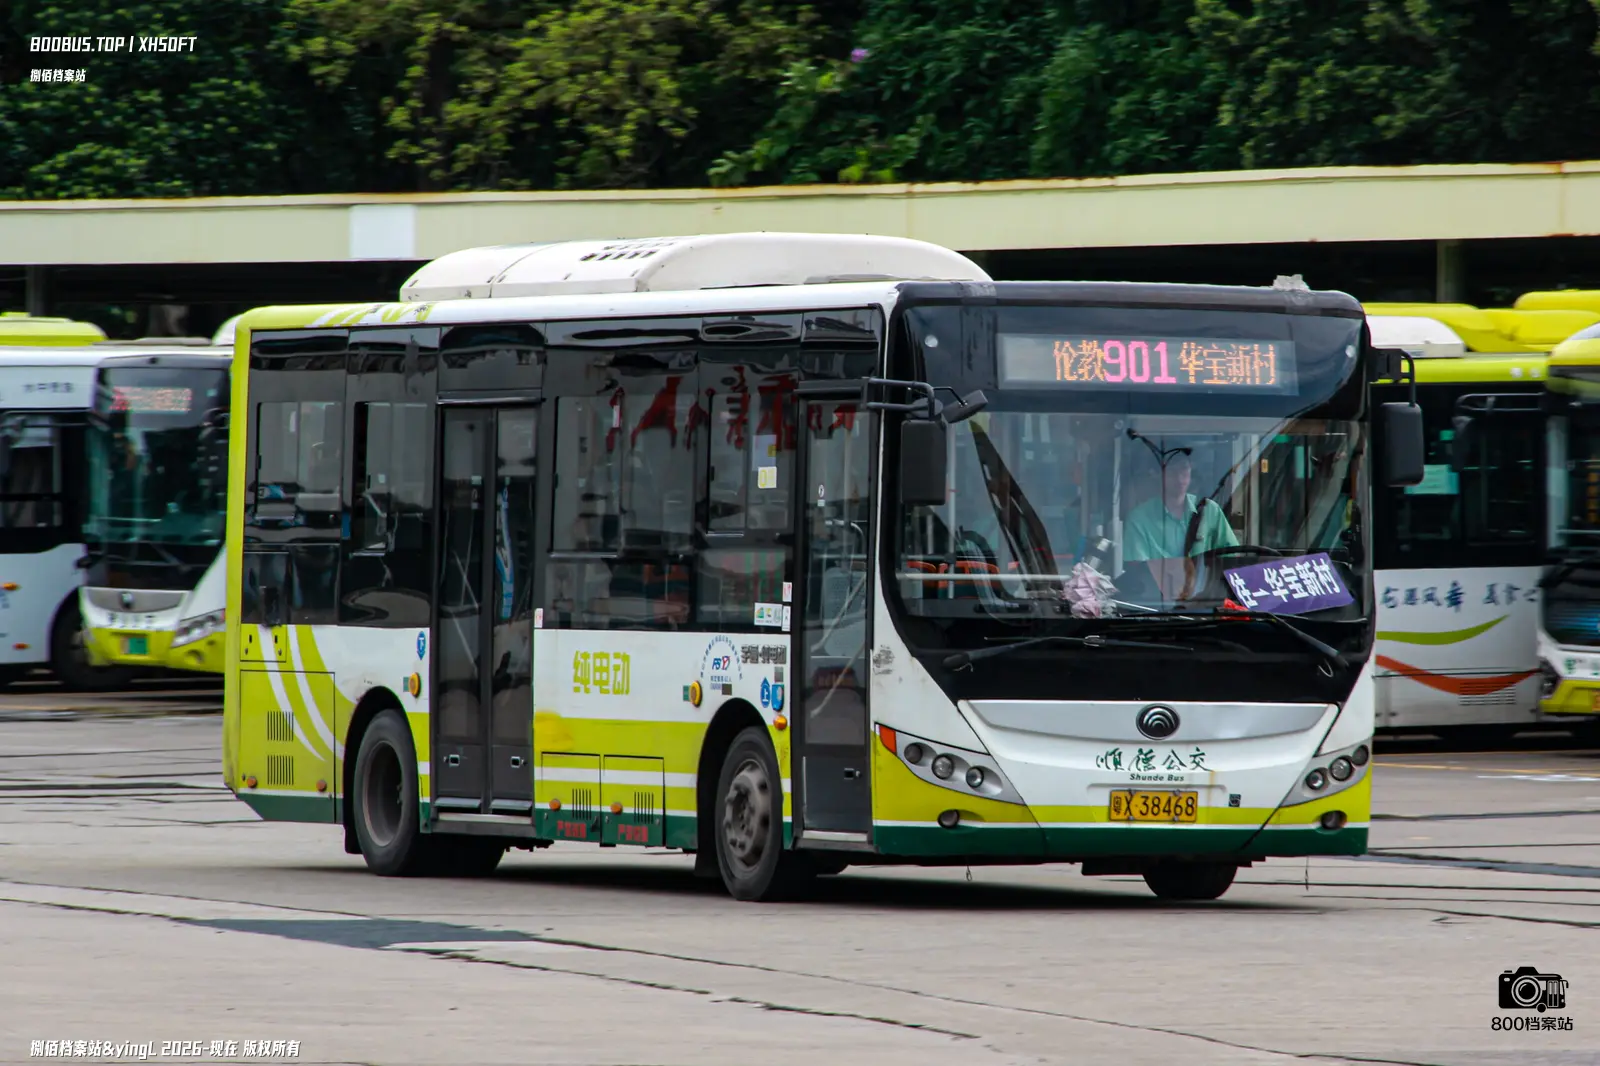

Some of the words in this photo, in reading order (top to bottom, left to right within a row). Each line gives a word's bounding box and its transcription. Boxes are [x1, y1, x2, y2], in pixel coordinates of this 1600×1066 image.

[1053, 339, 1105, 382] 伦教
[1103, 340, 1177, 384] 901
[1177, 341, 1276, 385] 华宝新村
[1263, 557, 1342, 603] 华宝新村
[573, 650, 631, 696] 纯电动
[1129, 773, 1165, 782] Shunde
[1167, 774, 1185, 782] Bus
